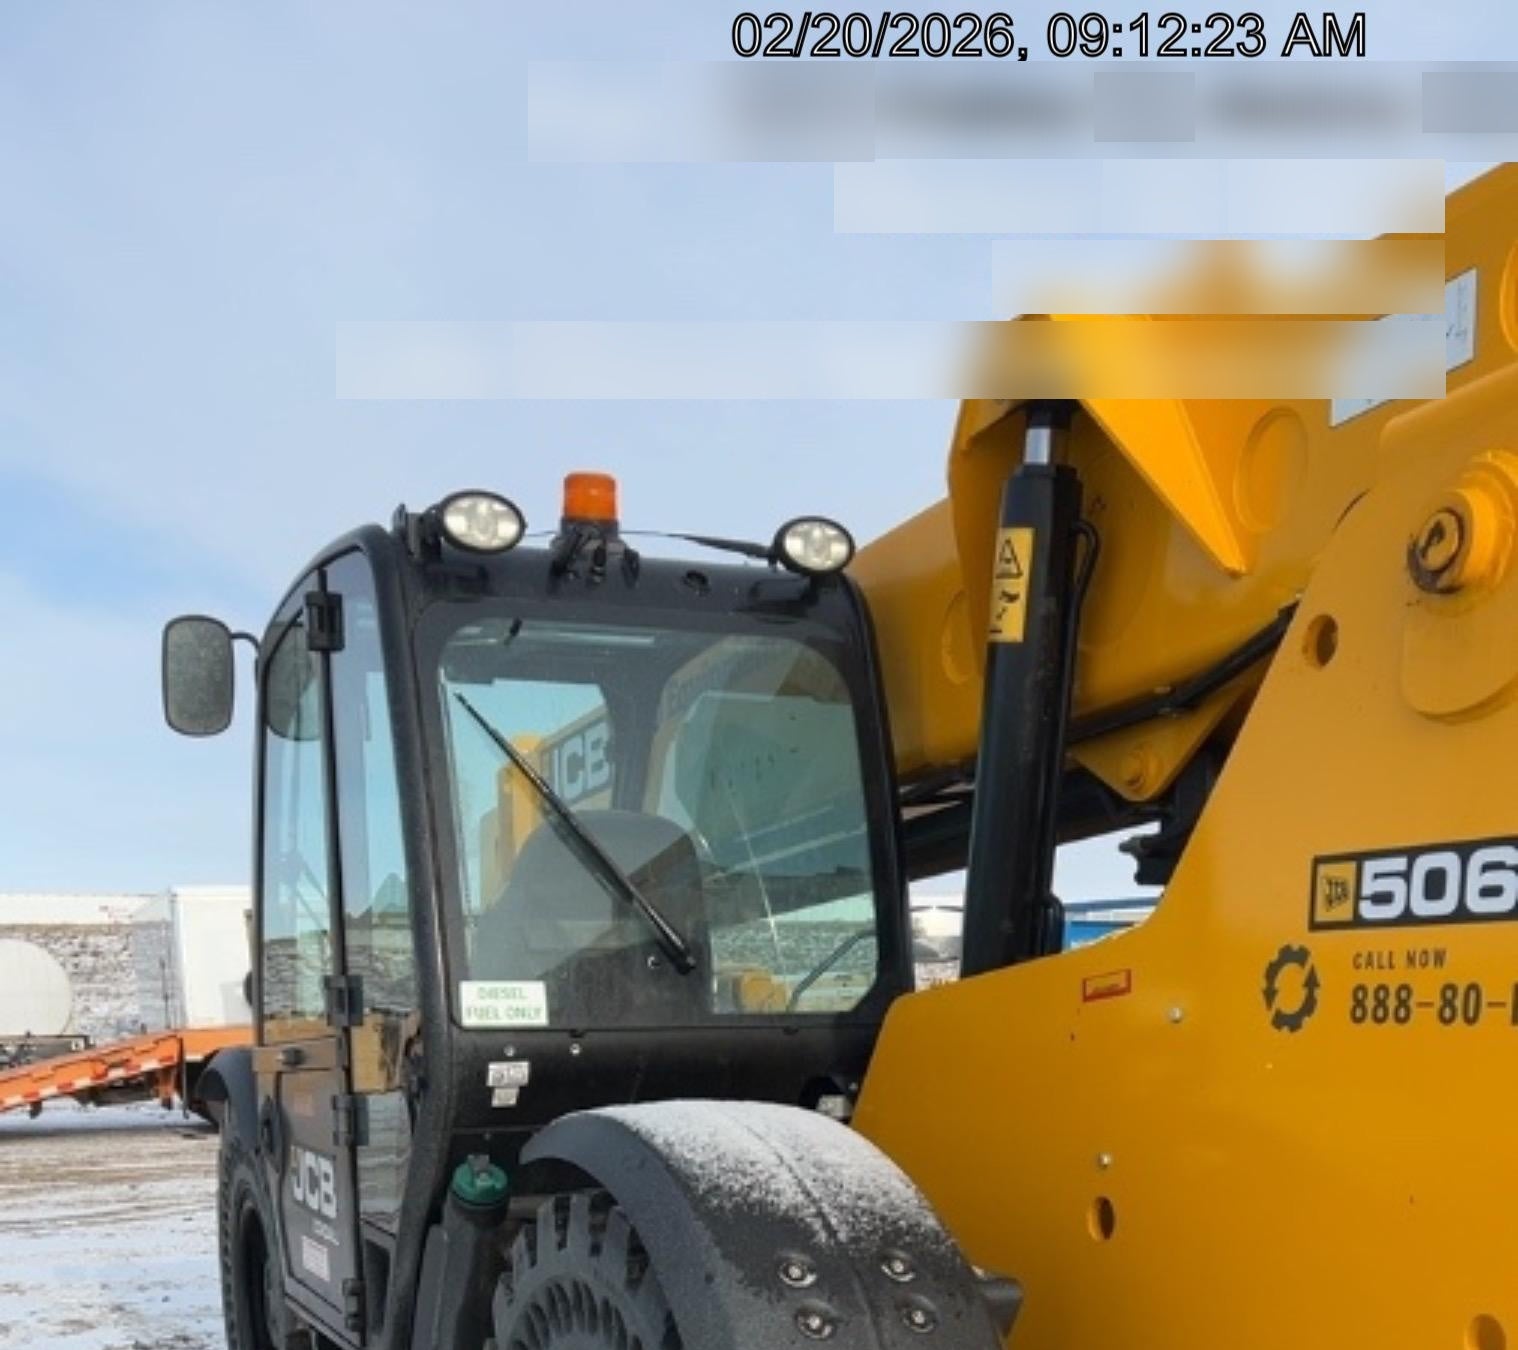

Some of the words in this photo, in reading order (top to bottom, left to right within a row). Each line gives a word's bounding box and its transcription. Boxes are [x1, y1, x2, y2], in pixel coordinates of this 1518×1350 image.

[1358, 846, 1518, 921] 506
[1352, 950, 1396, 970] CALL
[1406, 948, 1447, 969] NOW
[477, 986, 528, 1000] DIESEL
[466, 1006, 500, 1020] FUEL
[505, 1006, 542, 1020] ONLY
[291, 1145, 338, 1219] JCB
